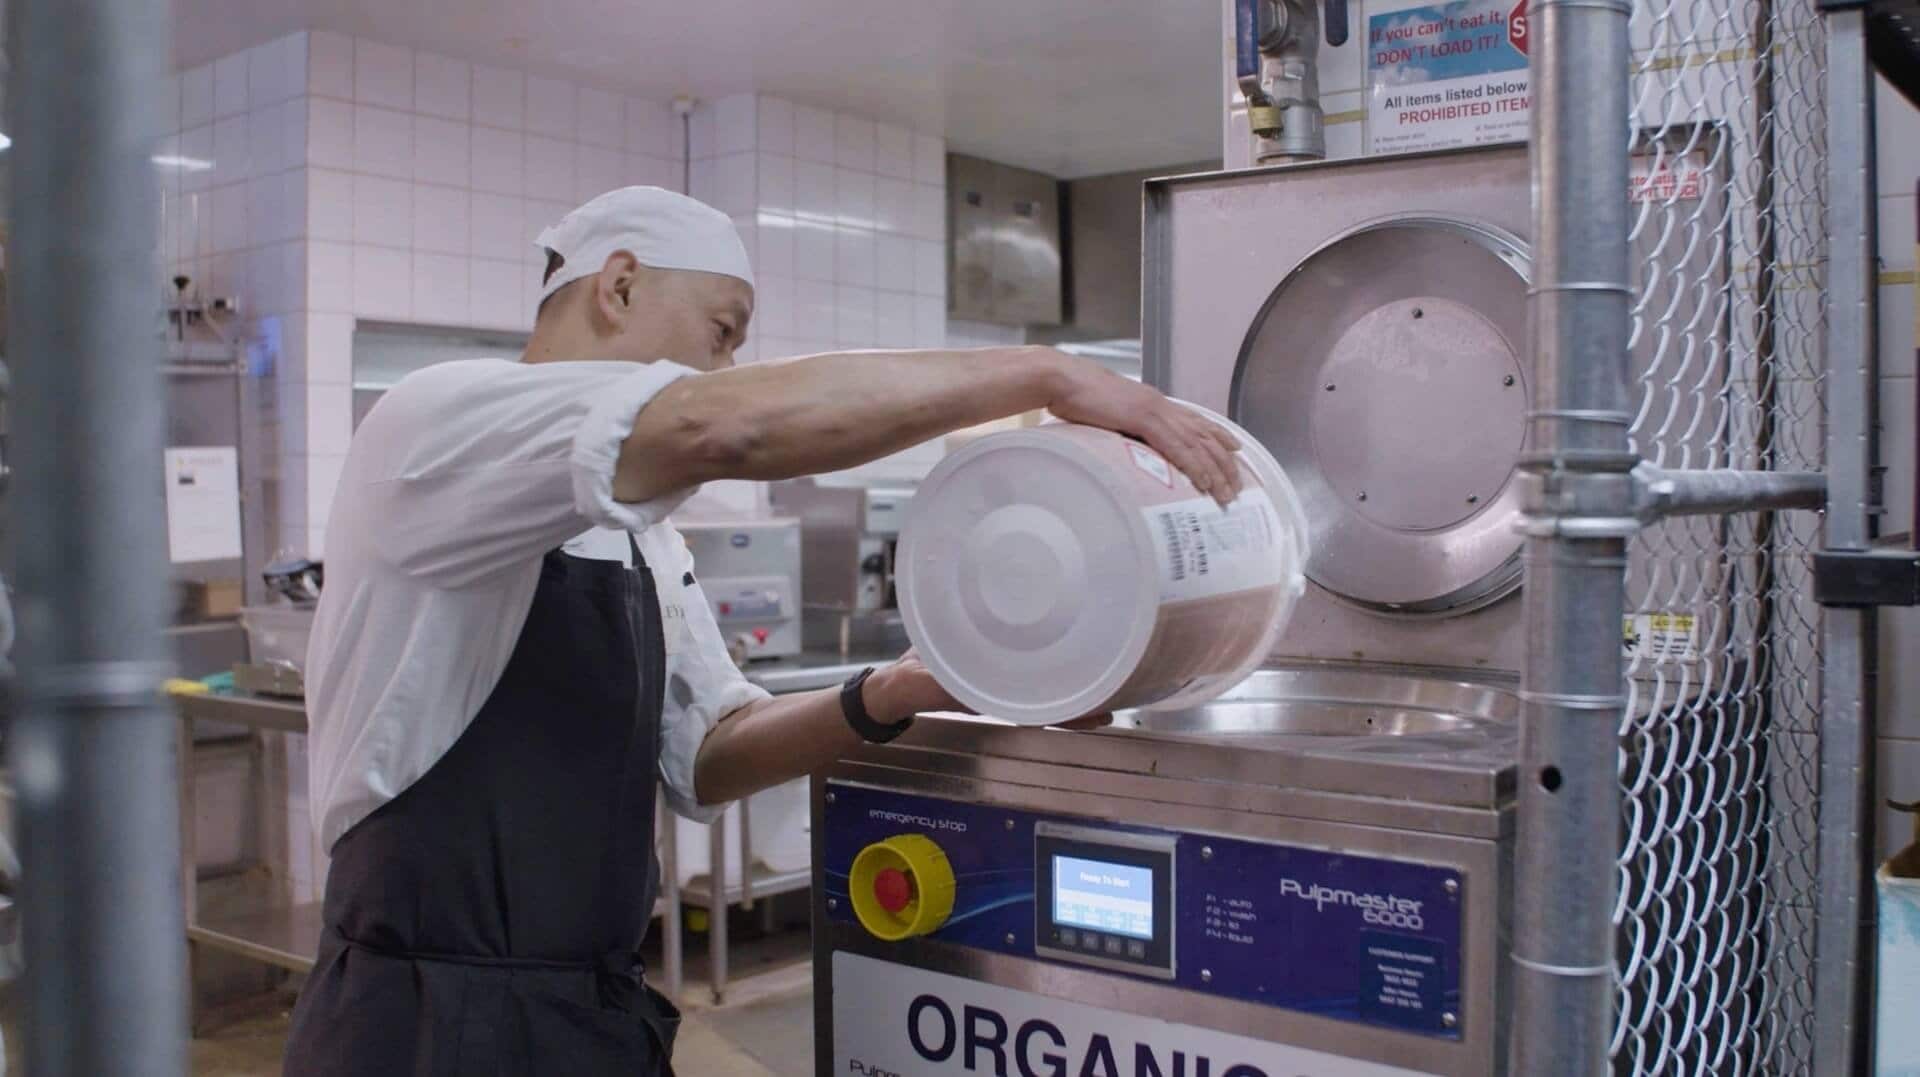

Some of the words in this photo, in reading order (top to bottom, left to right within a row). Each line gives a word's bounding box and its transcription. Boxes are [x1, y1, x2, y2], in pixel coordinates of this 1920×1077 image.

[1385, 26, 1413, 44] you
[1418, 16, 1454, 36] can't
[1460, 13, 1484, 31] eat
[1376, 45, 1425, 65] DON'T
[1431, 39, 1473, 58] LOAD
[1384, 96, 1401, 110] All
[1406, 92, 1441, 107] items
[1446, 85, 1482, 101] listed
[1487, 81, 1527, 97] below
[1400, 101, 1491, 125] PROHIBITED
[1496, 96, 1532, 113] ITEM
[869, 808, 937, 830] emergency
[938, 819, 968, 833] stop
[1280, 877, 1423, 914] Pulpmaster
[1363, 907, 1424, 930] 6000
